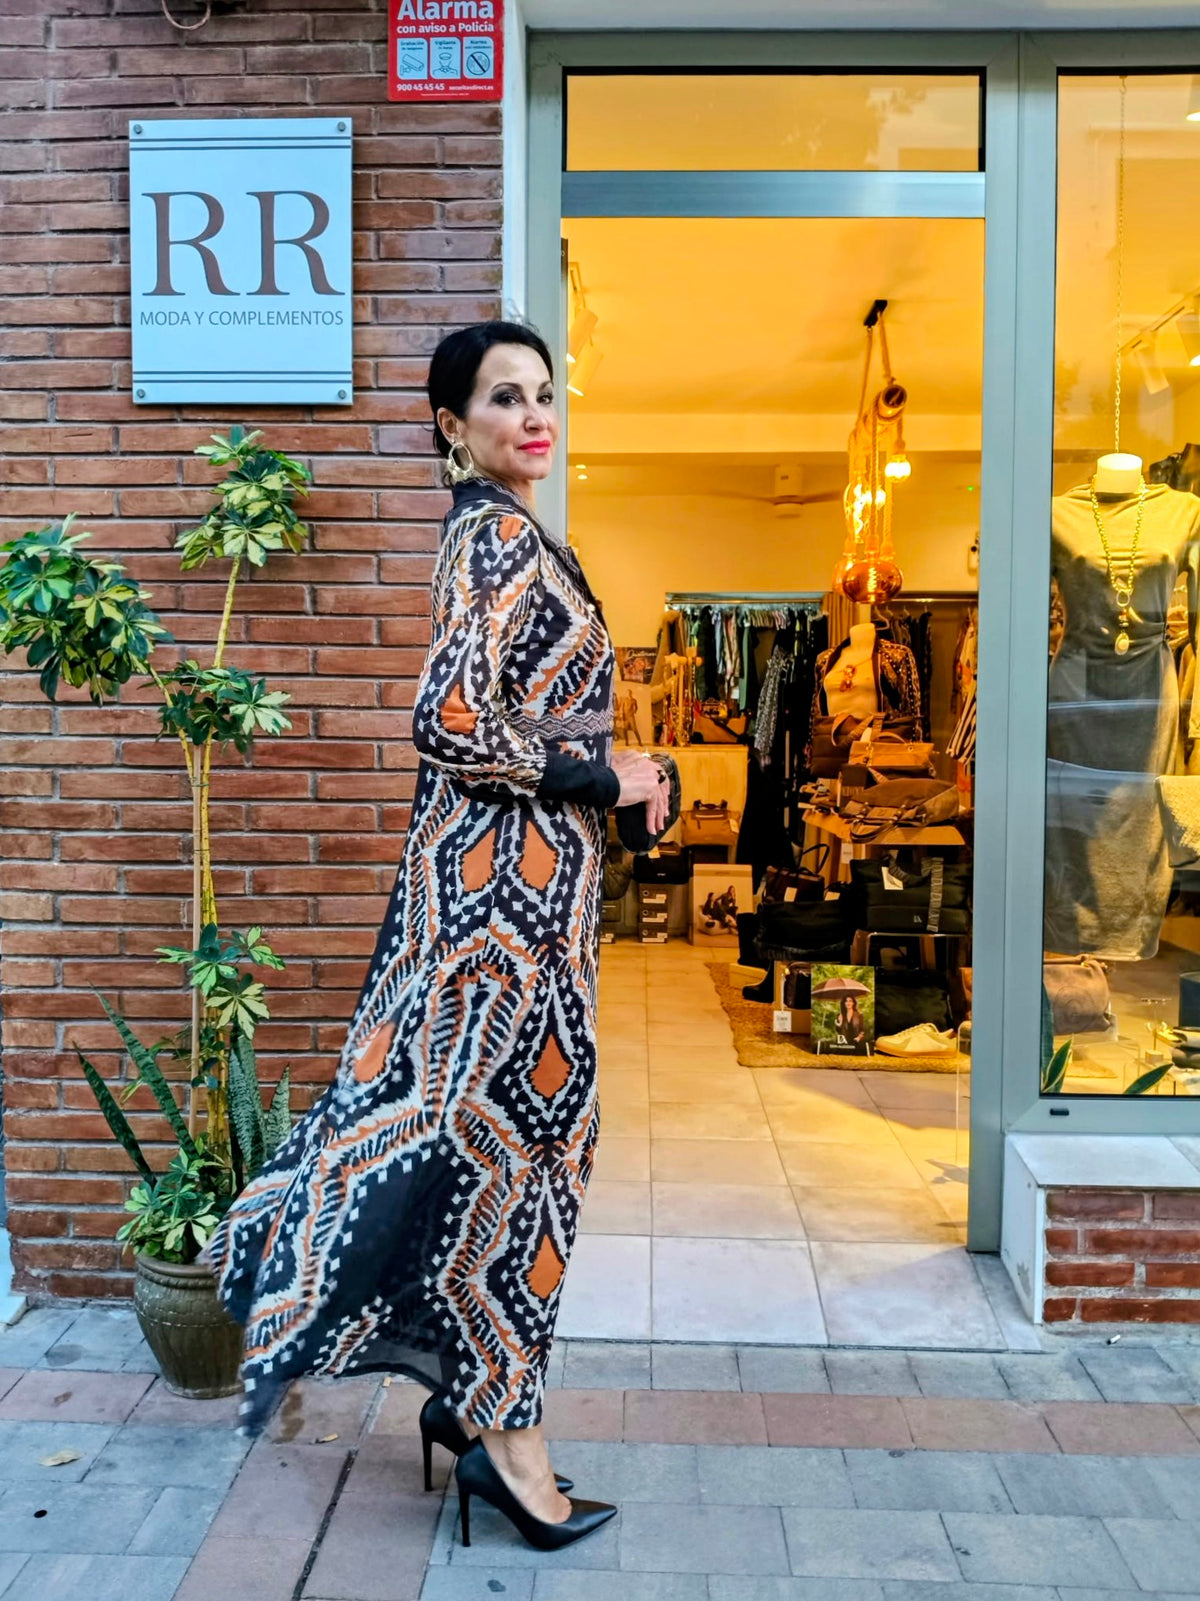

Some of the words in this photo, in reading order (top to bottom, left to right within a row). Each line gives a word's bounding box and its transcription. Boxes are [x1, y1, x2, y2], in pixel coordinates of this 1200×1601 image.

[397, 0, 494, 20] Alarma
[397, 25, 416, 34] con
[418, 22, 447, 33] aviso
[449, 24, 456, 32] a
[459, 21, 494, 32] Policía
[397, 83, 412, 91] 900
[413, 83, 423, 91] 45
[424, 83, 434, 91] 45
[434, 82, 445, 90] 45
[140, 310, 190, 326] MODA
[195, 310, 205, 326] Y
[209, 310, 344, 326] COMPLEMENTOS
